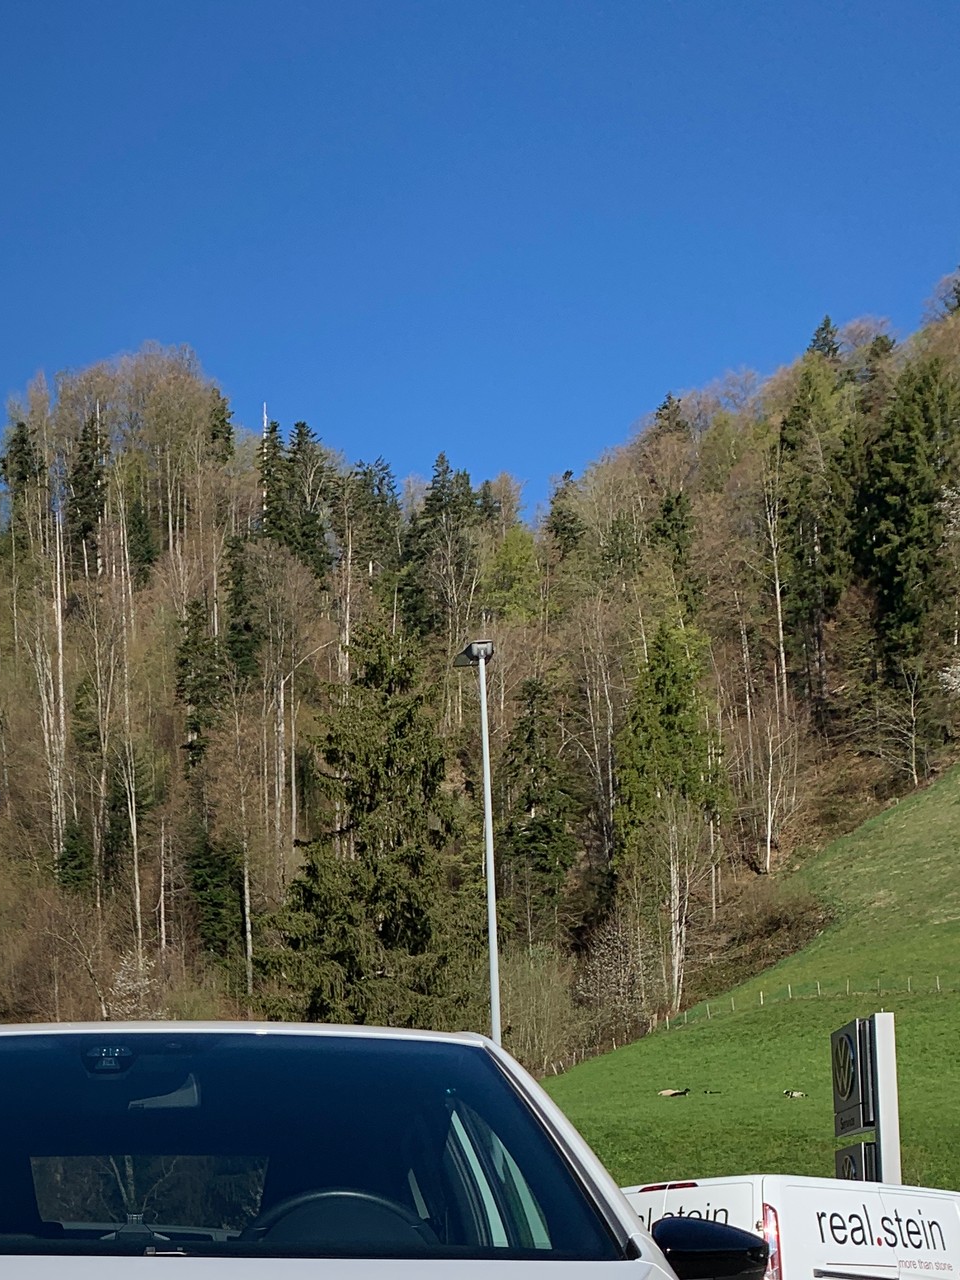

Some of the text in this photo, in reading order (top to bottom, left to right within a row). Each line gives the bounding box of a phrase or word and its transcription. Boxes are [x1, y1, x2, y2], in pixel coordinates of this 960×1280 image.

[816, 1204, 946, 1251] real.stein
[899, 1259, 954, 1272] more than stone
